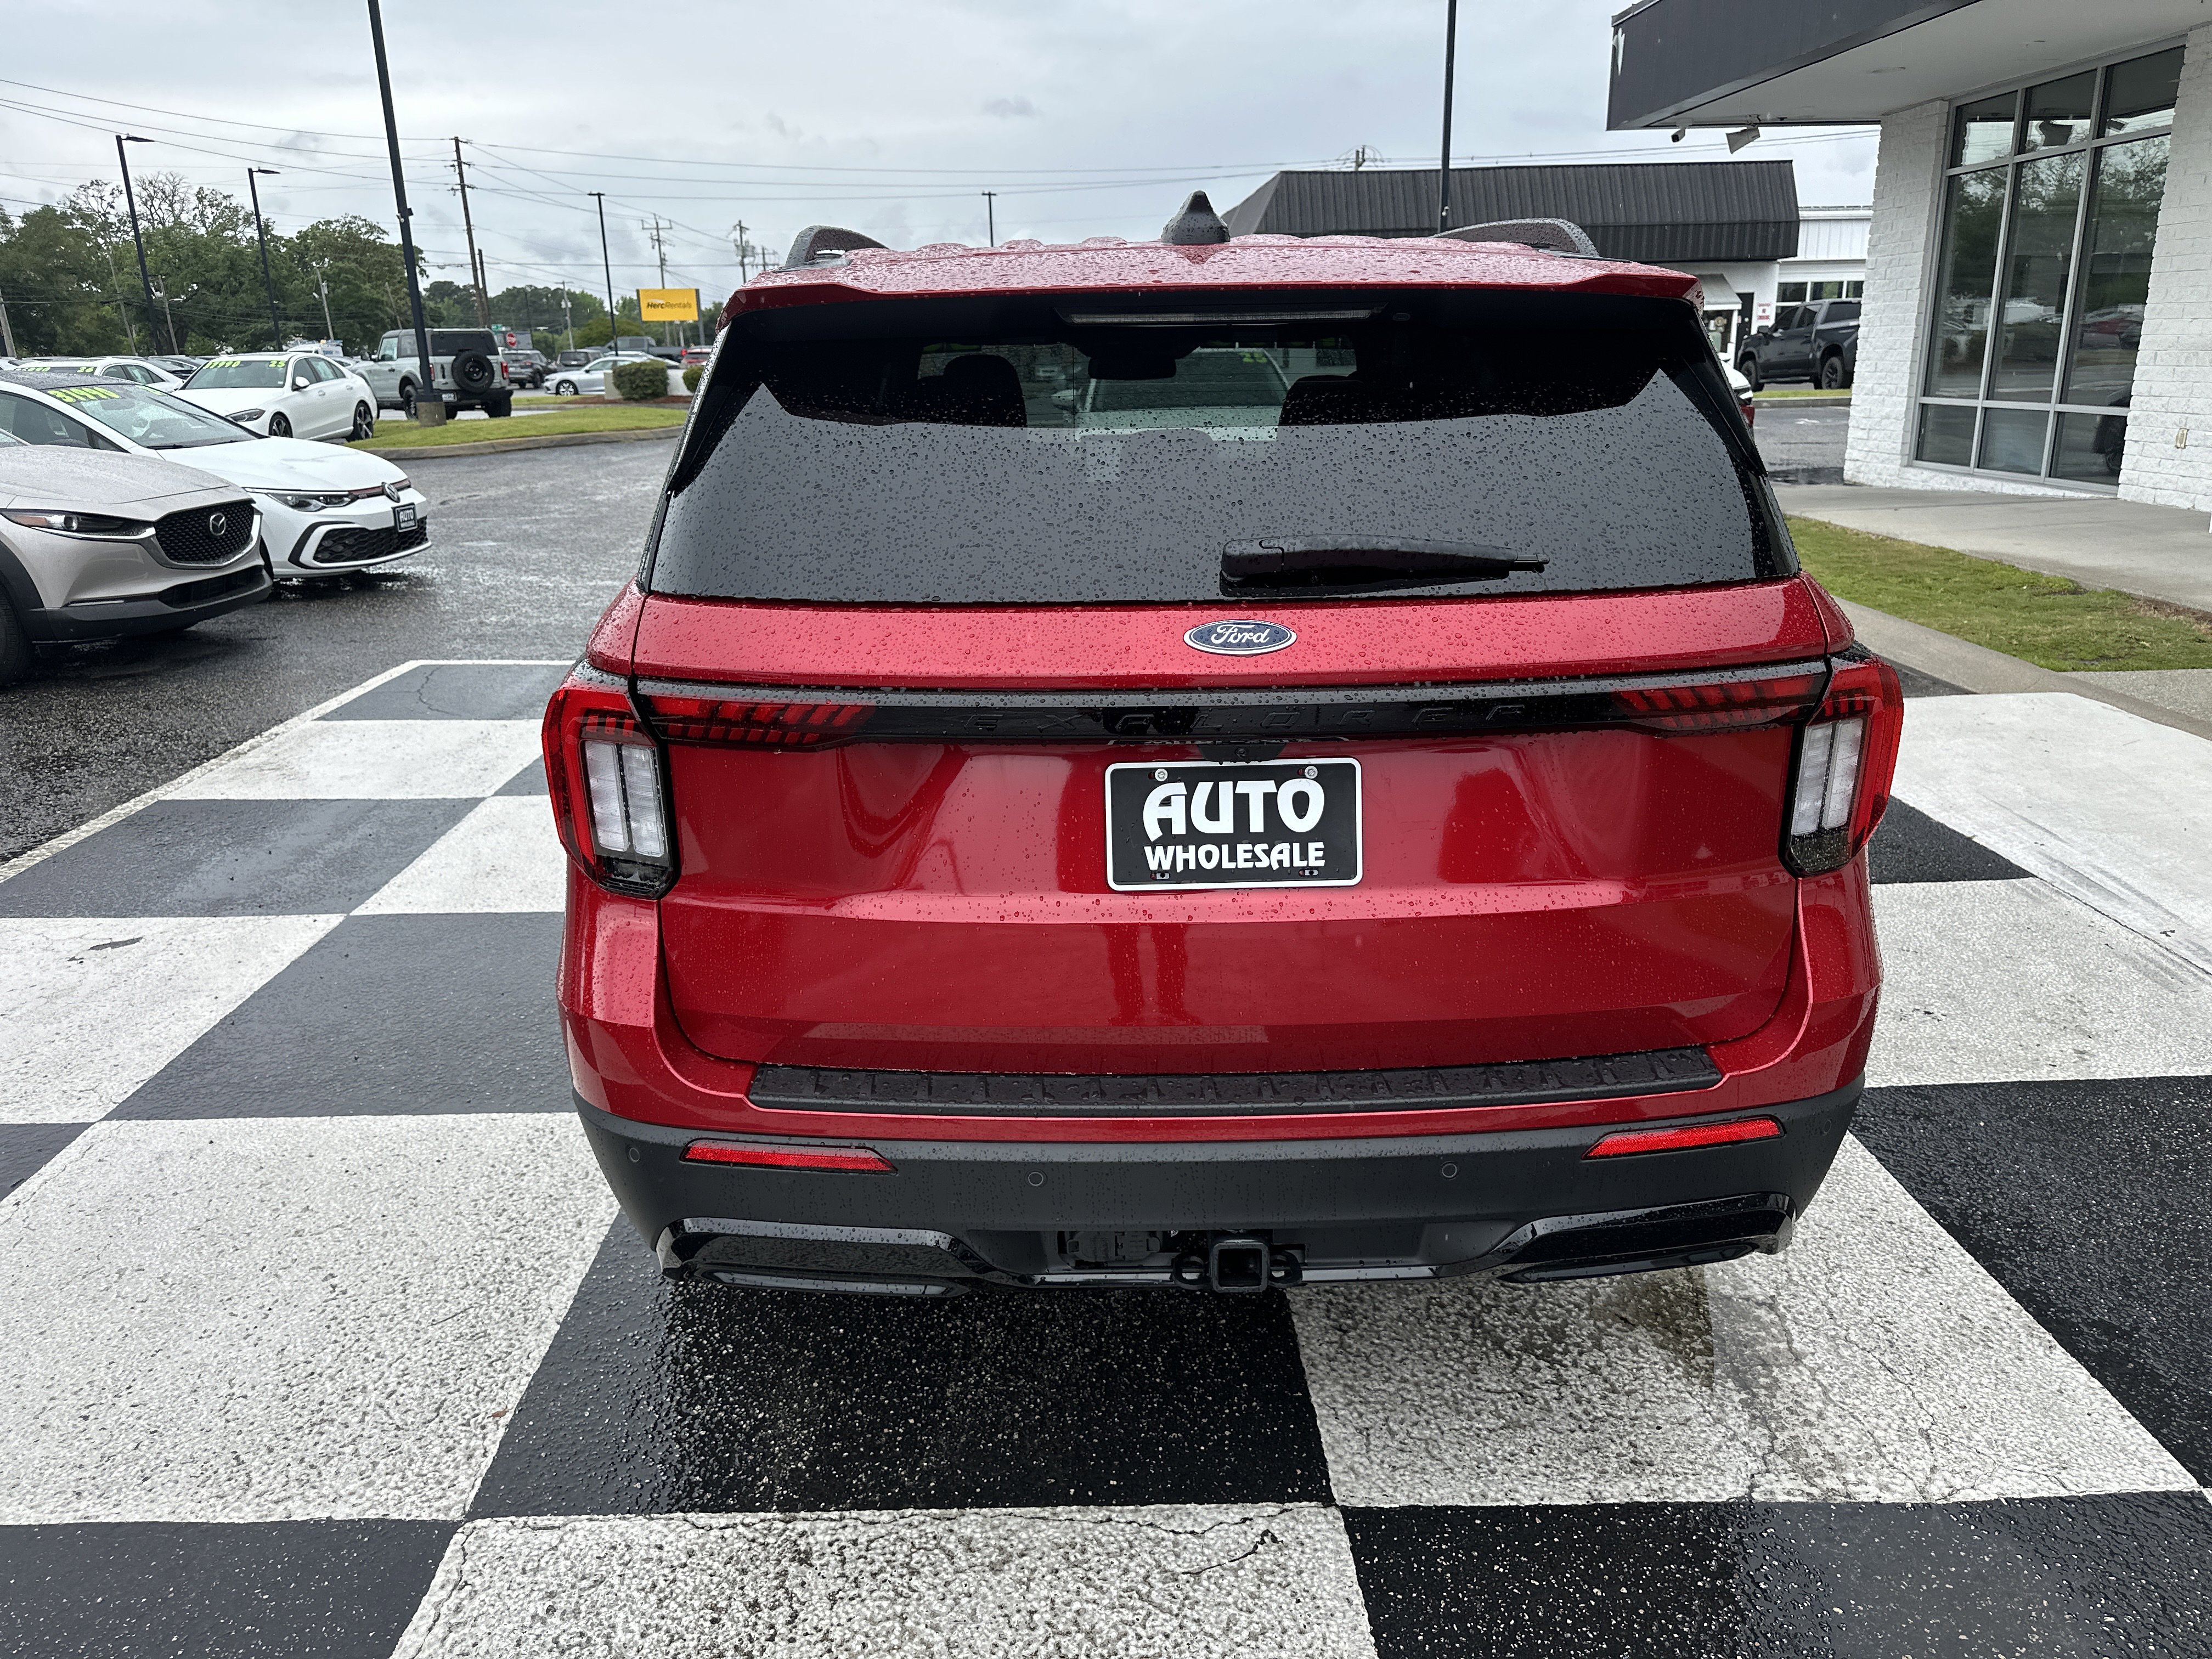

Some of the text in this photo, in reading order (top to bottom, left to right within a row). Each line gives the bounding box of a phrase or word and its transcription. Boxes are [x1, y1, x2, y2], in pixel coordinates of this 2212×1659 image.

[47, 386, 122, 403] 31990
[1211, 624, 1271, 644] Ford
[963, 704, 1525, 731] EXPLORER
[1143, 778, 1324, 842] AUTO
[1144, 842, 1325, 872] WHOLESALE
